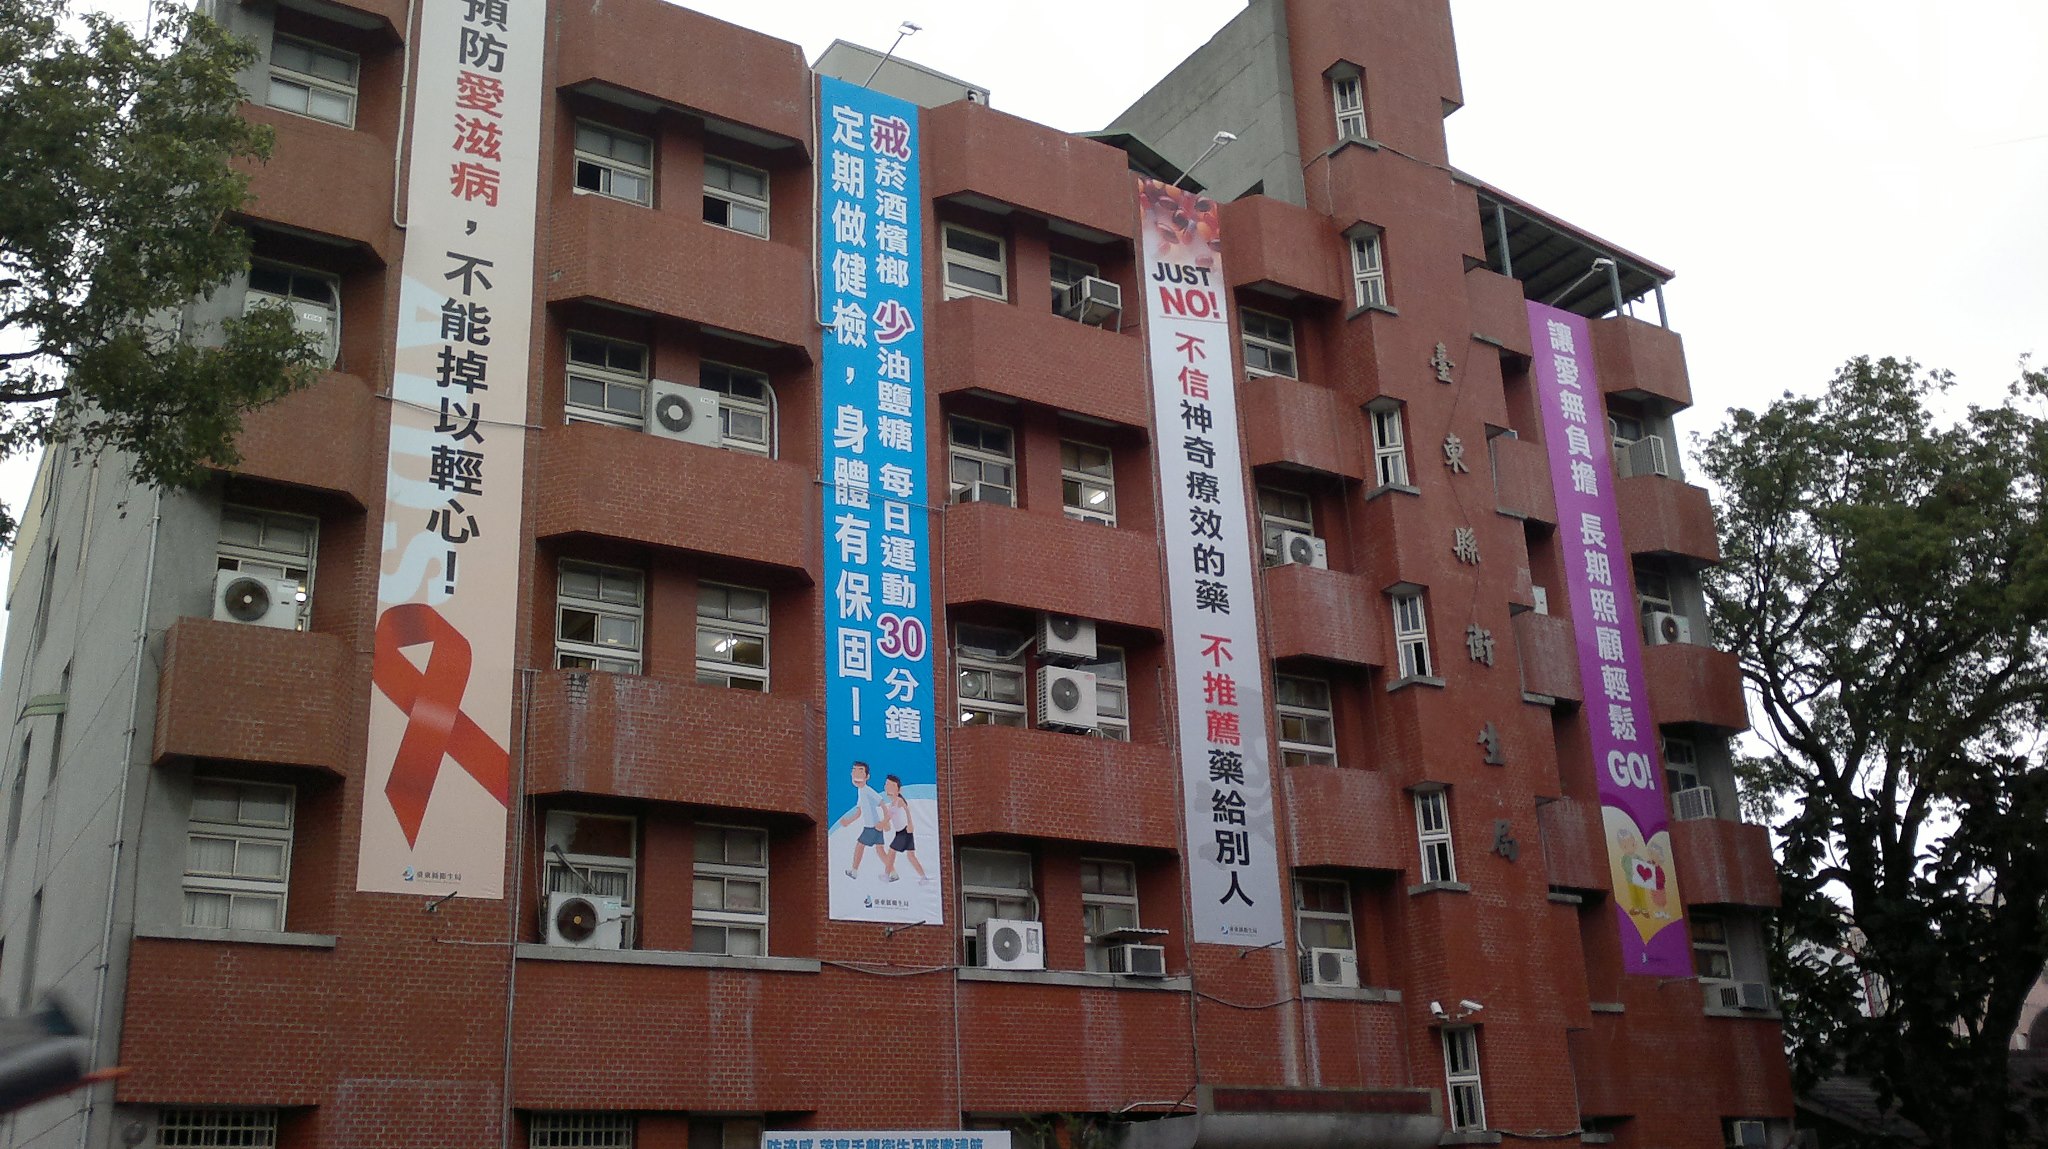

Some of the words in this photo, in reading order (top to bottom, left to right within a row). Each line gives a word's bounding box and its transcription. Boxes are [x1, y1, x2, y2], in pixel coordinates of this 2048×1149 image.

[870, 114, 911, 288] 戒菸酒檳榔
[1152, 261, 1212, 287] JUST
[873, 299, 915, 453] 少油鹽糖
[1158, 285, 1221, 320] NO!
[1175, 332, 1231, 616] 不信神奇療效的藥
[1546, 318, 1599, 497] 讓愛無負擔
[876, 462, 926, 743] 每日運動30分鐘
[1580, 511, 1638, 742] 長期照顧輕鬆
[1200, 633, 1255, 908] 不推薦藥給別人
[1607, 749, 1656, 791] GO!
